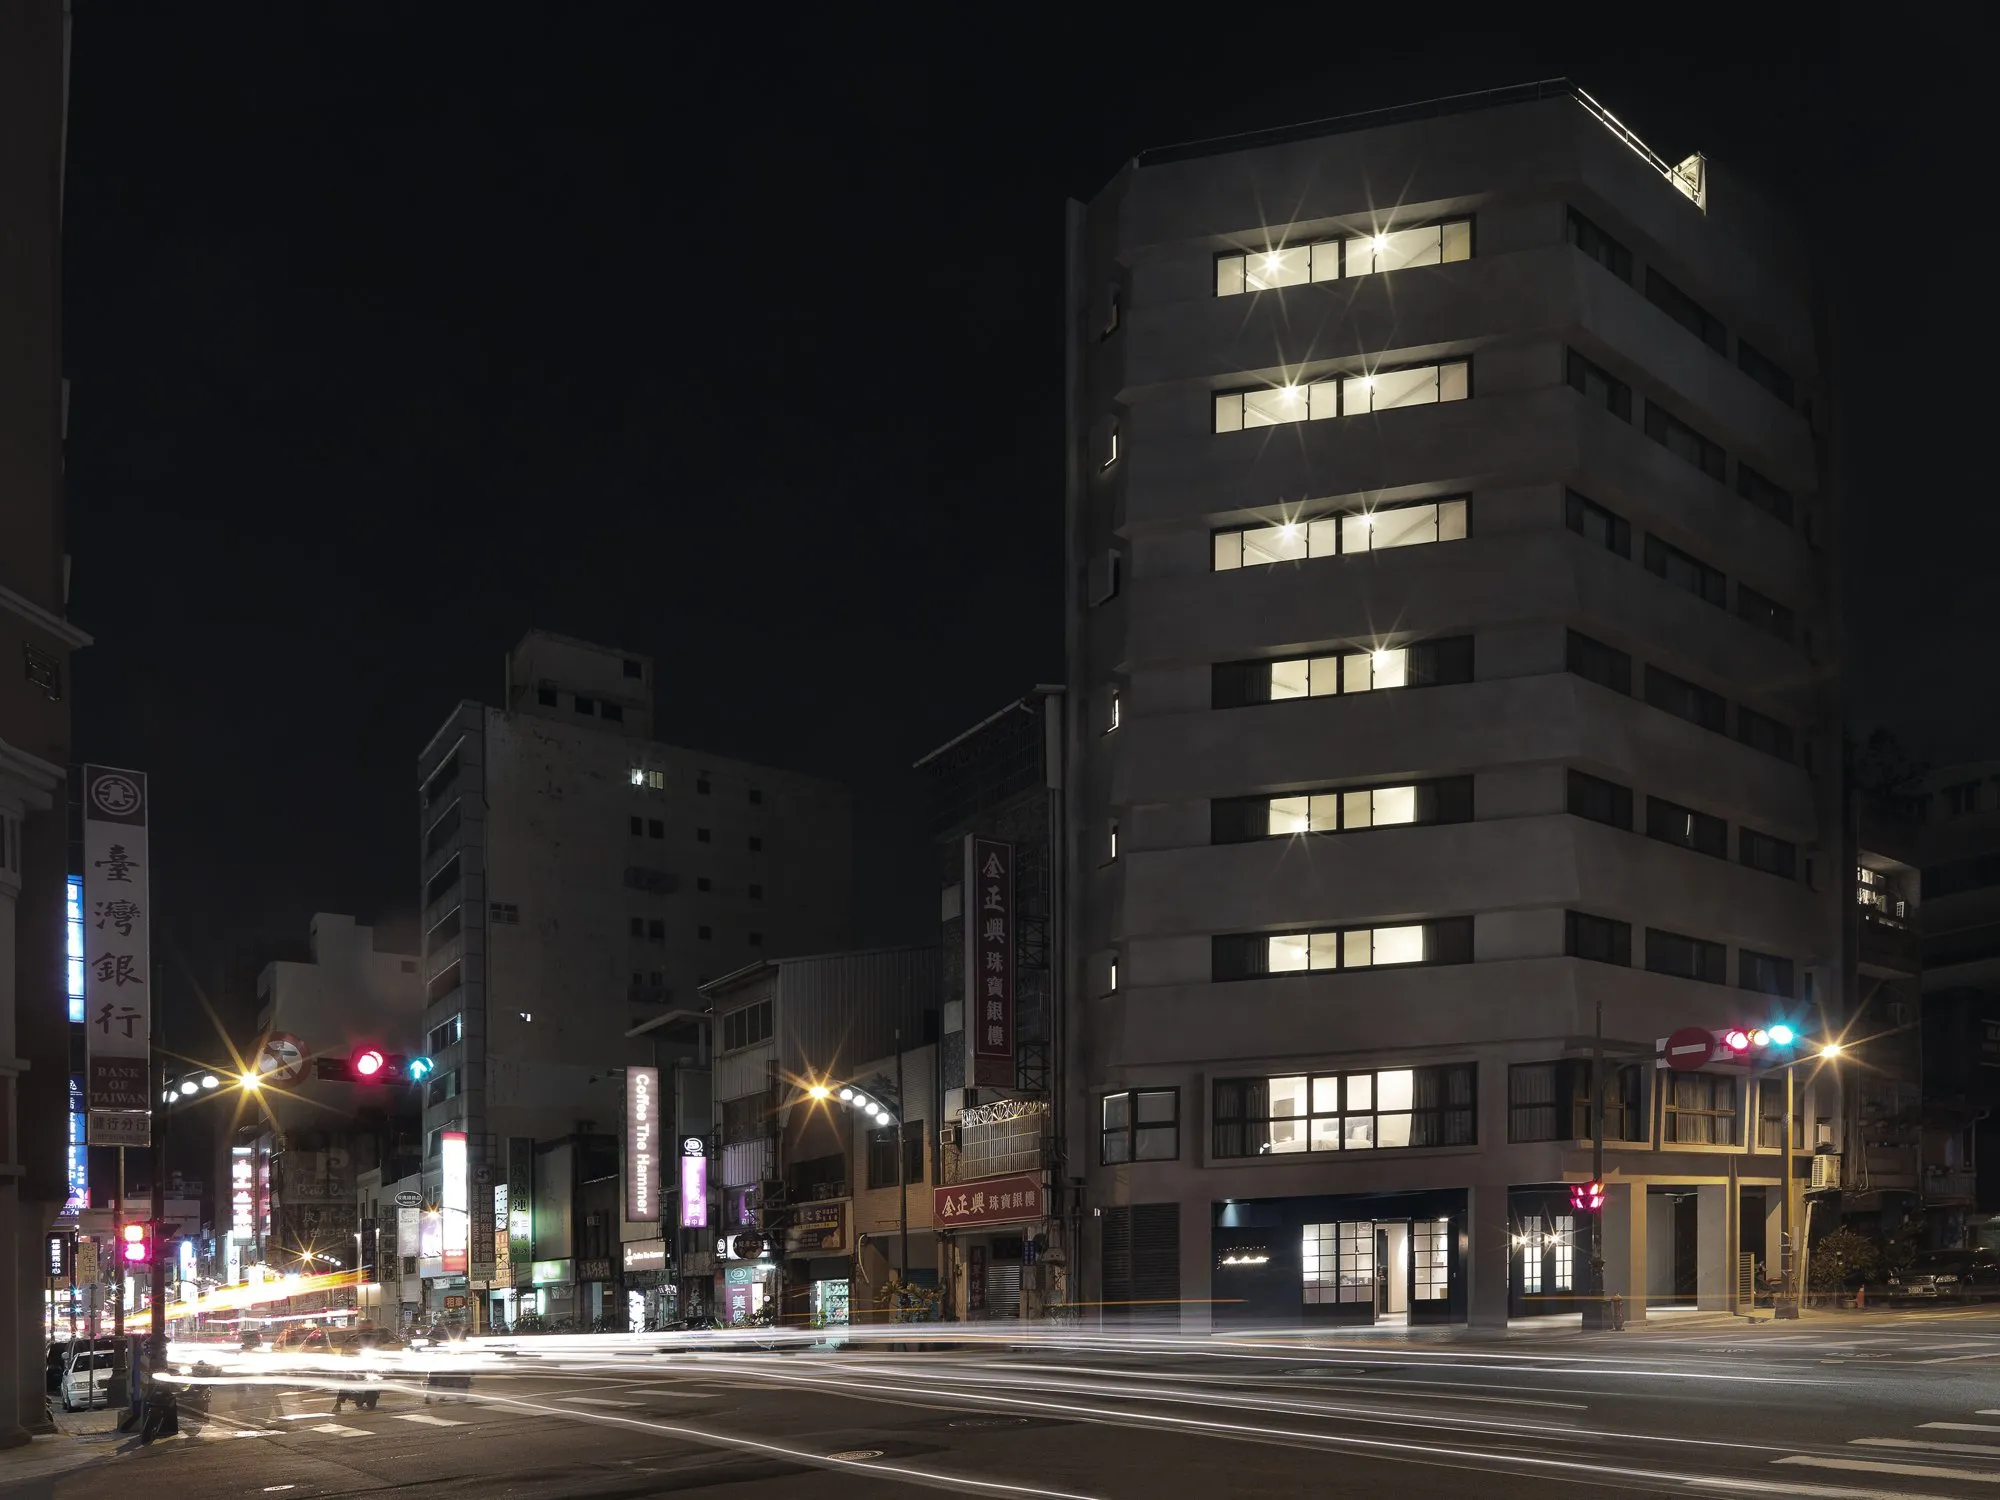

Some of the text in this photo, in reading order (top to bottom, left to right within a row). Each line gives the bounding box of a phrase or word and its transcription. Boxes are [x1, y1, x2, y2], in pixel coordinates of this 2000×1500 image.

[92, 844, 144, 1039] 臺灣銀行
[97, 1066, 139, 1078] BANK
[108, 1080, 129, 1090] OF
[92, 1092, 147, 1104] TAIWAN
[635, 1073, 650, 1215] Coffee The Hammer
